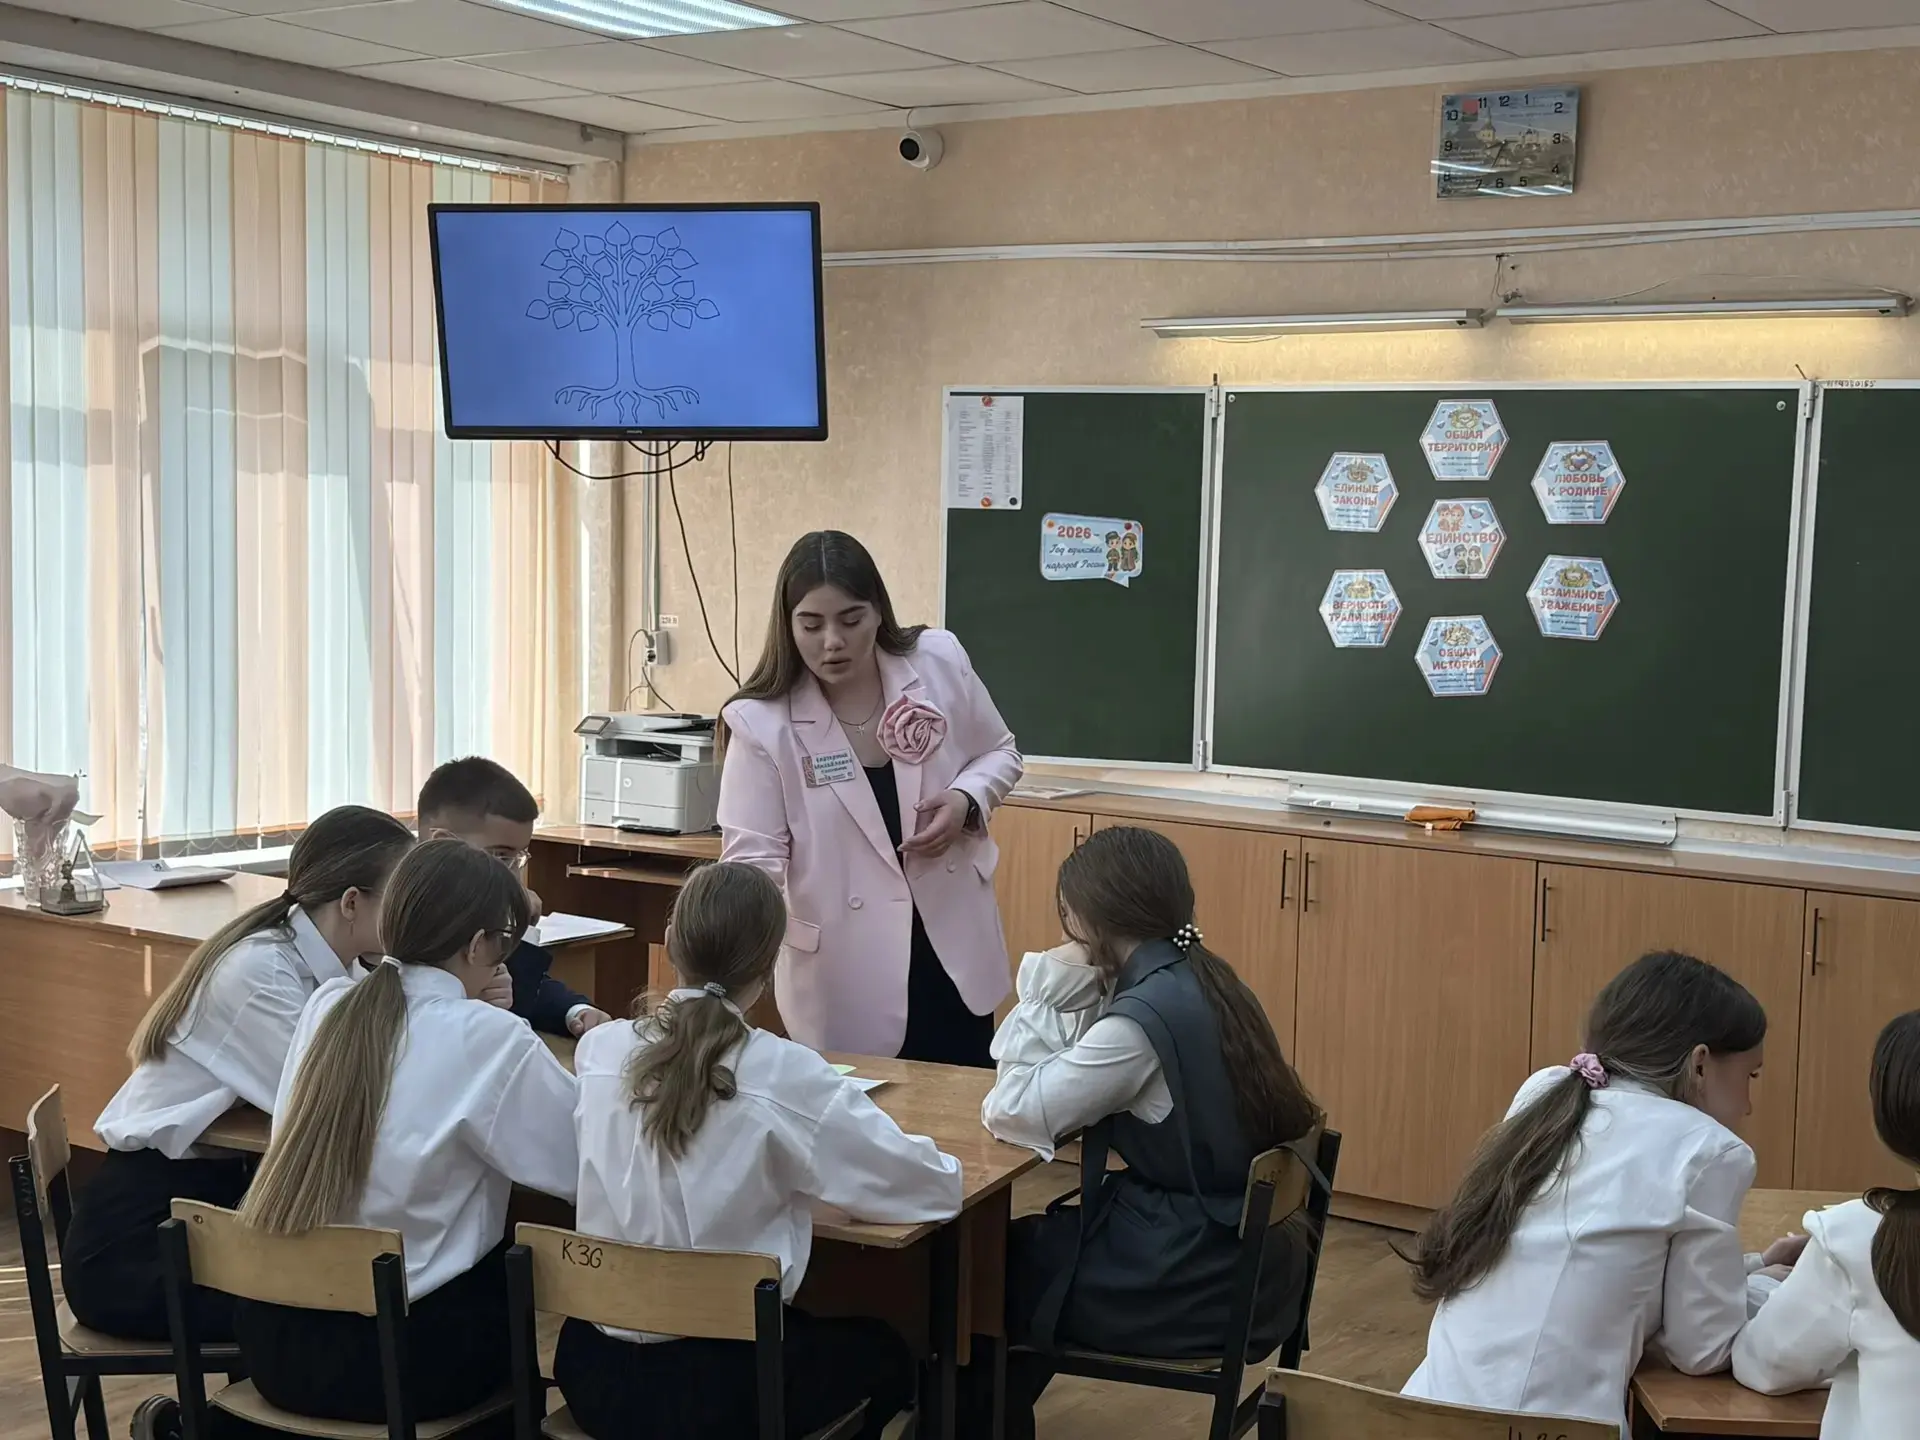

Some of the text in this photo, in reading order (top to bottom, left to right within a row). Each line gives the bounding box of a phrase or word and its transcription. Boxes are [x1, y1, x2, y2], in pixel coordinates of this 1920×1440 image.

[1478, 97, 1487, 108] 11
[1499, 95, 1510, 107] 12
[1524, 94, 1529, 105] 1
[1554, 102, 1563, 113] 2
[1445, 109, 1458, 121] 10
[1552, 133, 1561, 144] 3
[1444, 140, 1453, 151] 9
[1551, 164, 1559, 174] 4
[1495, 177, 1504, 188] 6
[1519, 177, 1527, 187] 5
[1444, 430, 1483, 440] ОБЩАЯ
[1427, 442, 1501, 452] ТЕРРИТОРИЯ
[1554, 473, 1605, 484] ЛЮБОВЬ
[1333, 483, 1380, 494] ЕДИНЫЕ
[1547, 486, 1608, 497] К РОДИНЕ
[1332, 495, 1378, 506] ЗАКОНЫ
[1057, 525, 1091, 539] 2026
[1426, 531, 1498, 545] ЕДИНСТВО
[1049, 543, 1065, 555] Год
[1045, 560, 1078, 572] народов
[1541, 587, 1605, 600] ВЗАИМНОЕ
[1540, 599, 1604, 613] УВАЖЕНИЕ
[1439, 647, 1477, 657] ОБЩАЯ
[1432, 660, 1485, 670] ИСТОРИЯ
